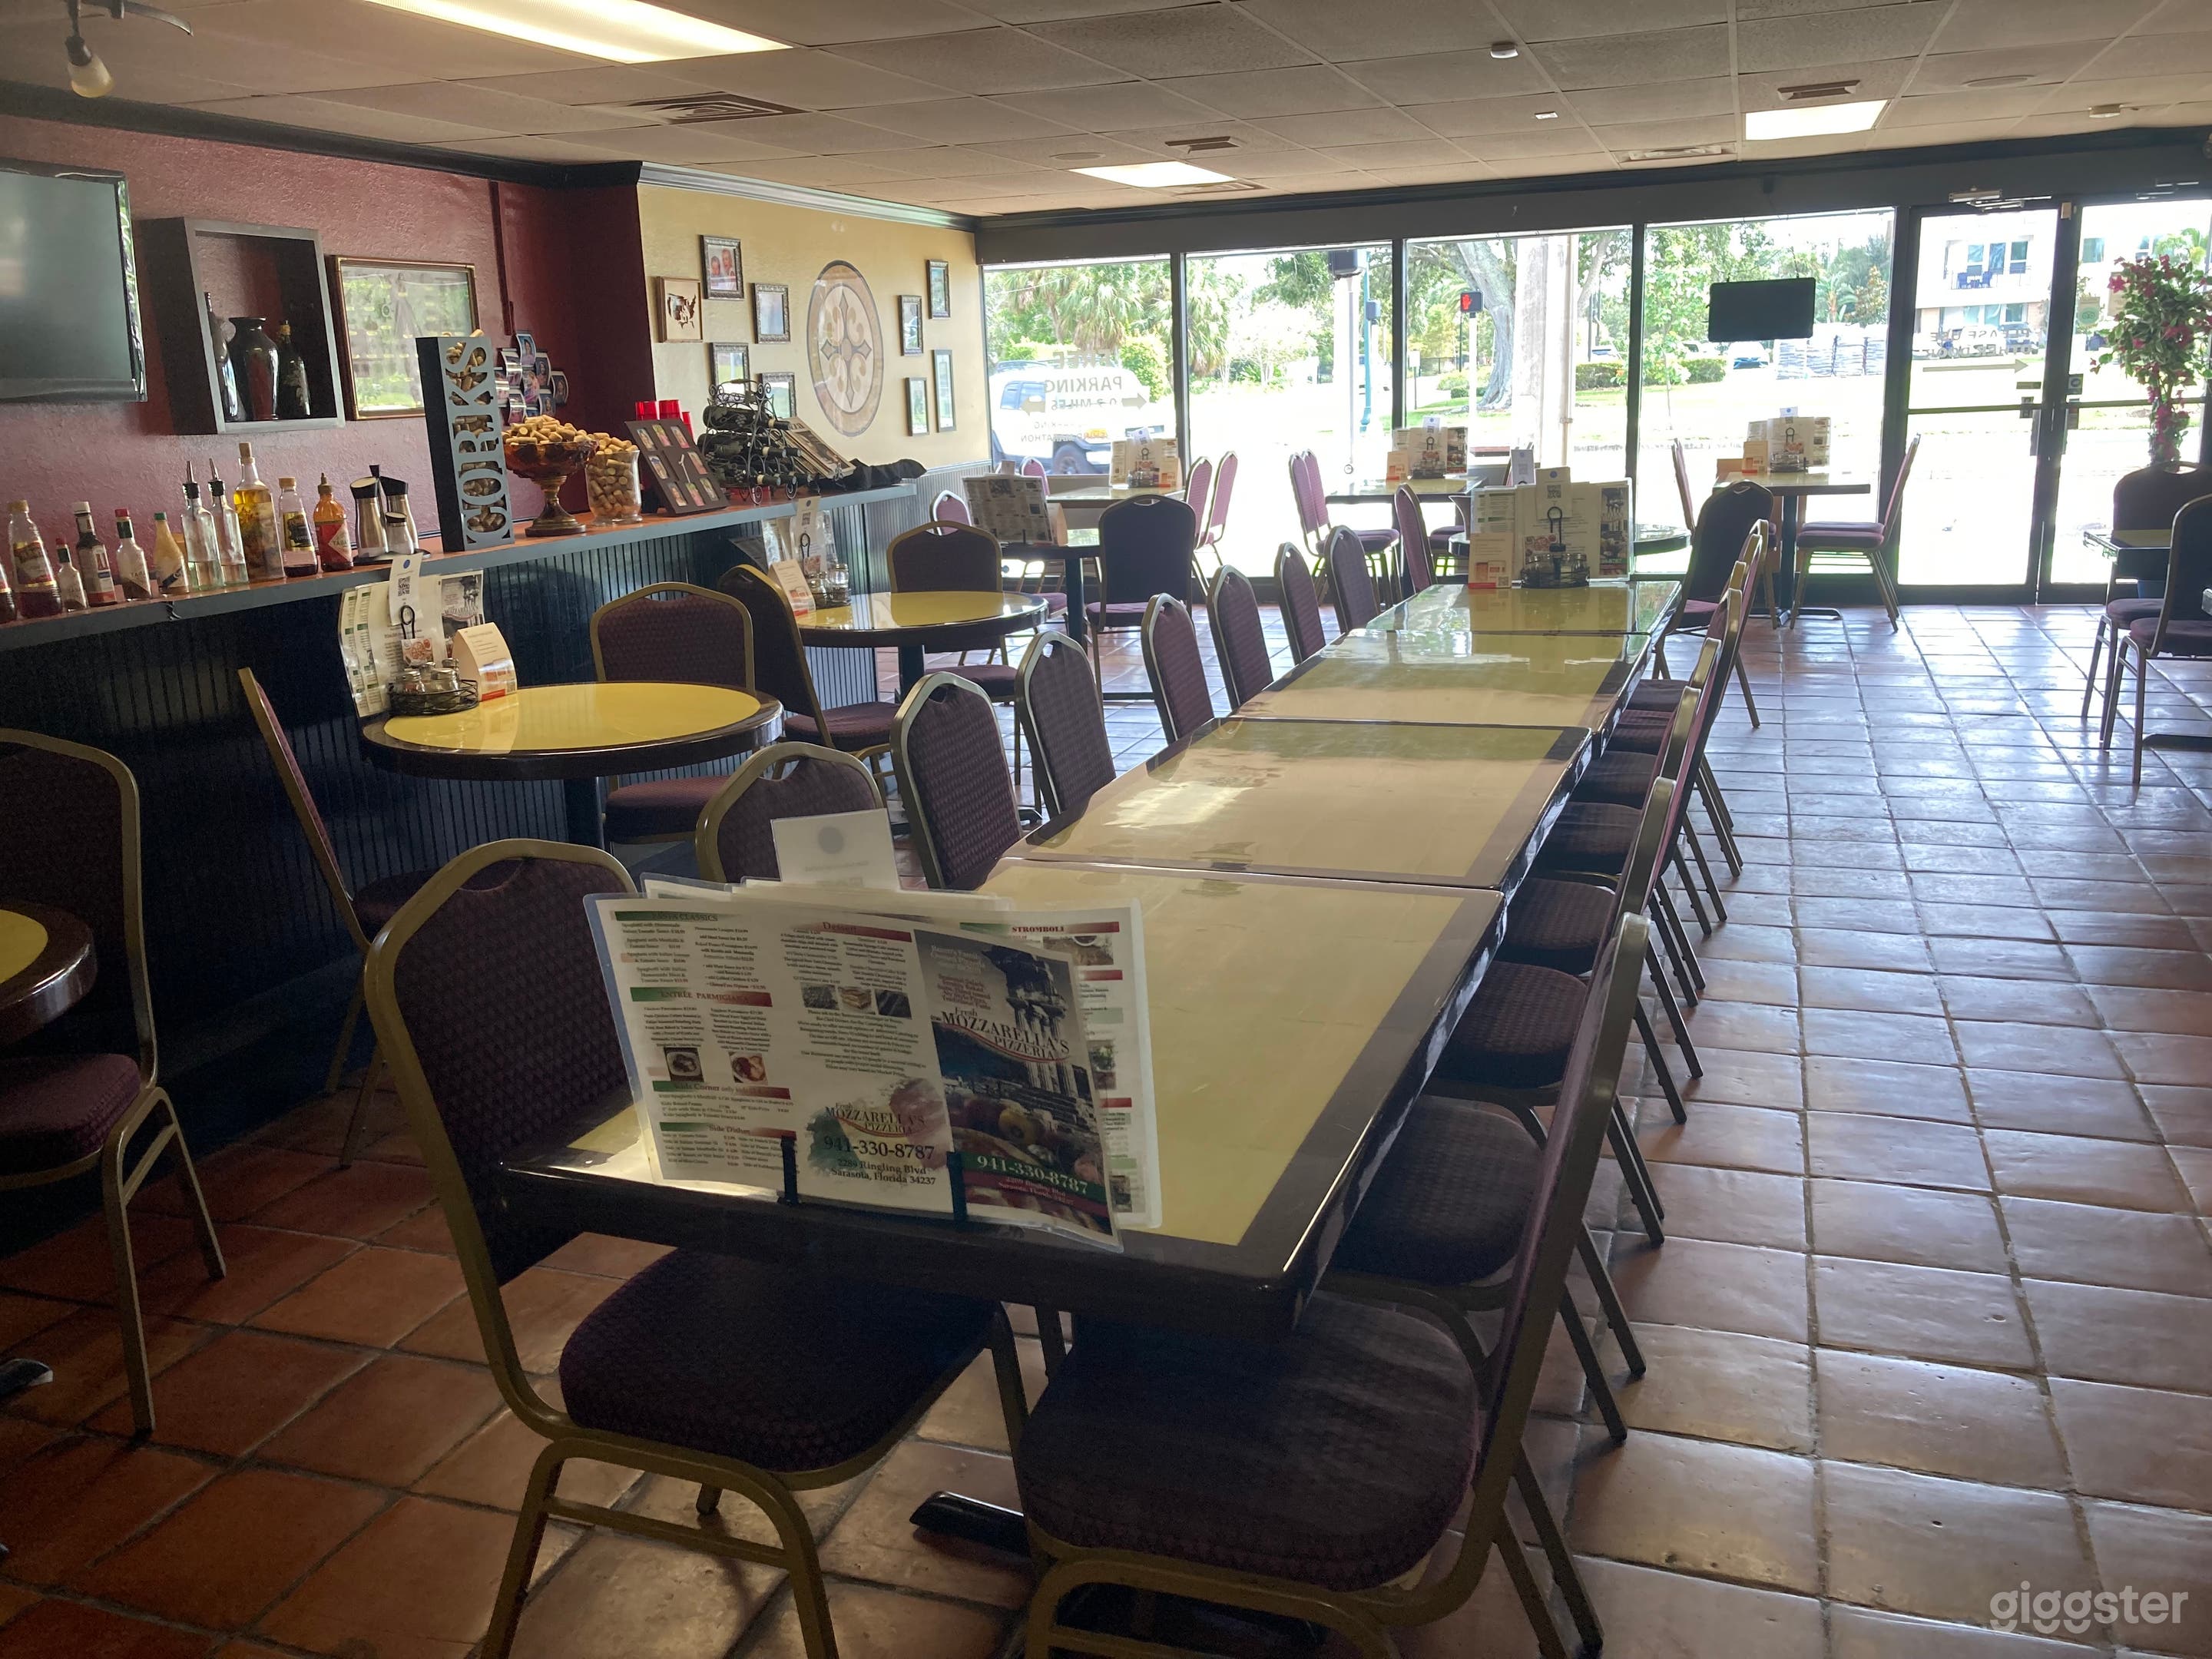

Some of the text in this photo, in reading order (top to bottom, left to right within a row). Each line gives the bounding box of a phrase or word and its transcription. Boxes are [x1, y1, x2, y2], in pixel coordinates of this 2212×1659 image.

[444, 339, 512, 544] CORKS
[1012, 925, 1065, 933] STROMBOLI
[955, 1007, 978, 1017] Fresh
[941, 1011, 1070, 1054] MOZZARELLA'S
[994, 1036, 1055, 1060] PIZZERIA
[826, 1107, 926, 1124] MOZZARELLA'S
[823, 1135, 935, 1161] 941-330-8787
[831, 1167, 936, 1185] Sarasota, Florida 34237
[860, 1161, 902, 1175] Ringling
[904, 1164, 926, 1174] Blvd
[976, 1154, 1088, 1195] 941-330-8787
